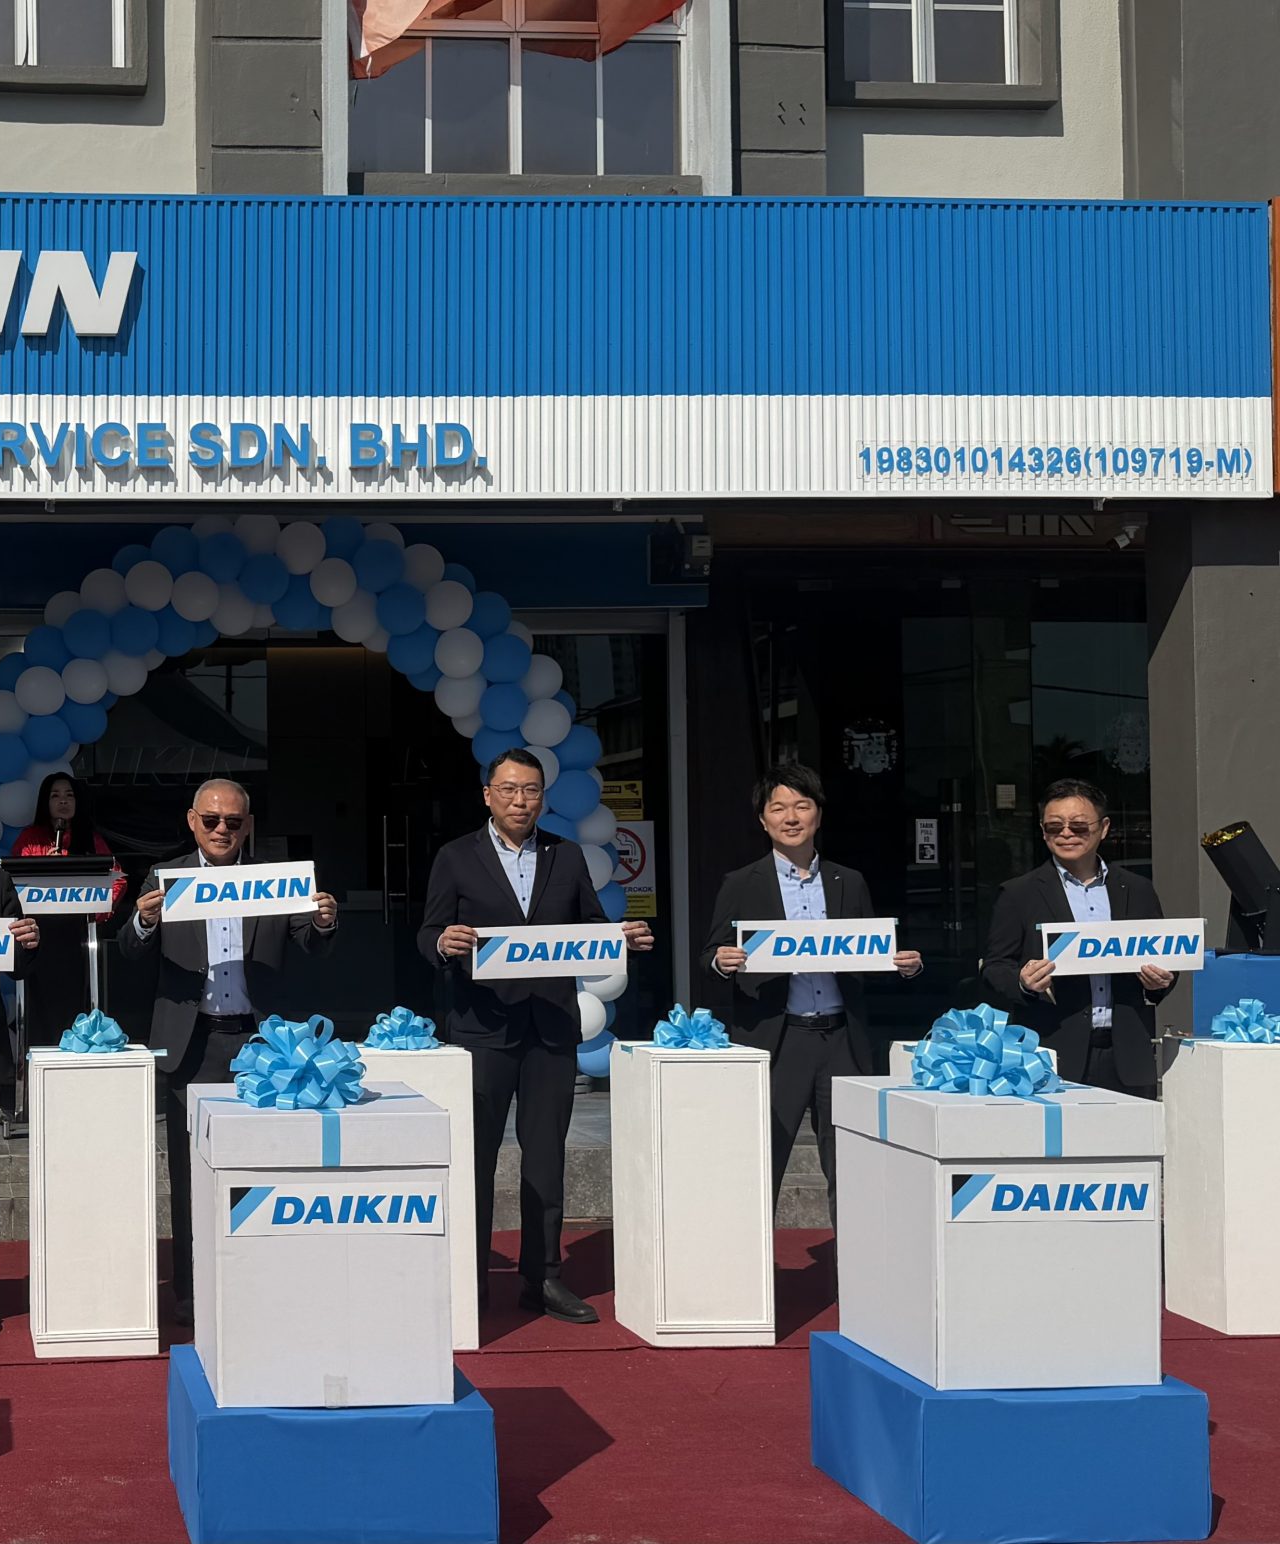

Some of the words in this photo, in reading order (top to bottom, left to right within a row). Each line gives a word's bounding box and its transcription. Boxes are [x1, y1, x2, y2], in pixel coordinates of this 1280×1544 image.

[189, 423, 327, 469] SDN.
[350, 423, 488, 469] BHD.
[858, 446, 1253, 478] 198301014326(109719-M)
[26, 887, 110, 903] DAIKIN
[195, 876, 311, 904] DAIKIN
[506, 938, 622, 963] DAIKIN
[772, 934, 892, 957] DAIKIN
[1077, 935, 1200, 957] DAIKIN
[271, 1195, 437, 1225] DAIKIN
[991, 1183, 1149, 1212] DAIKIN
